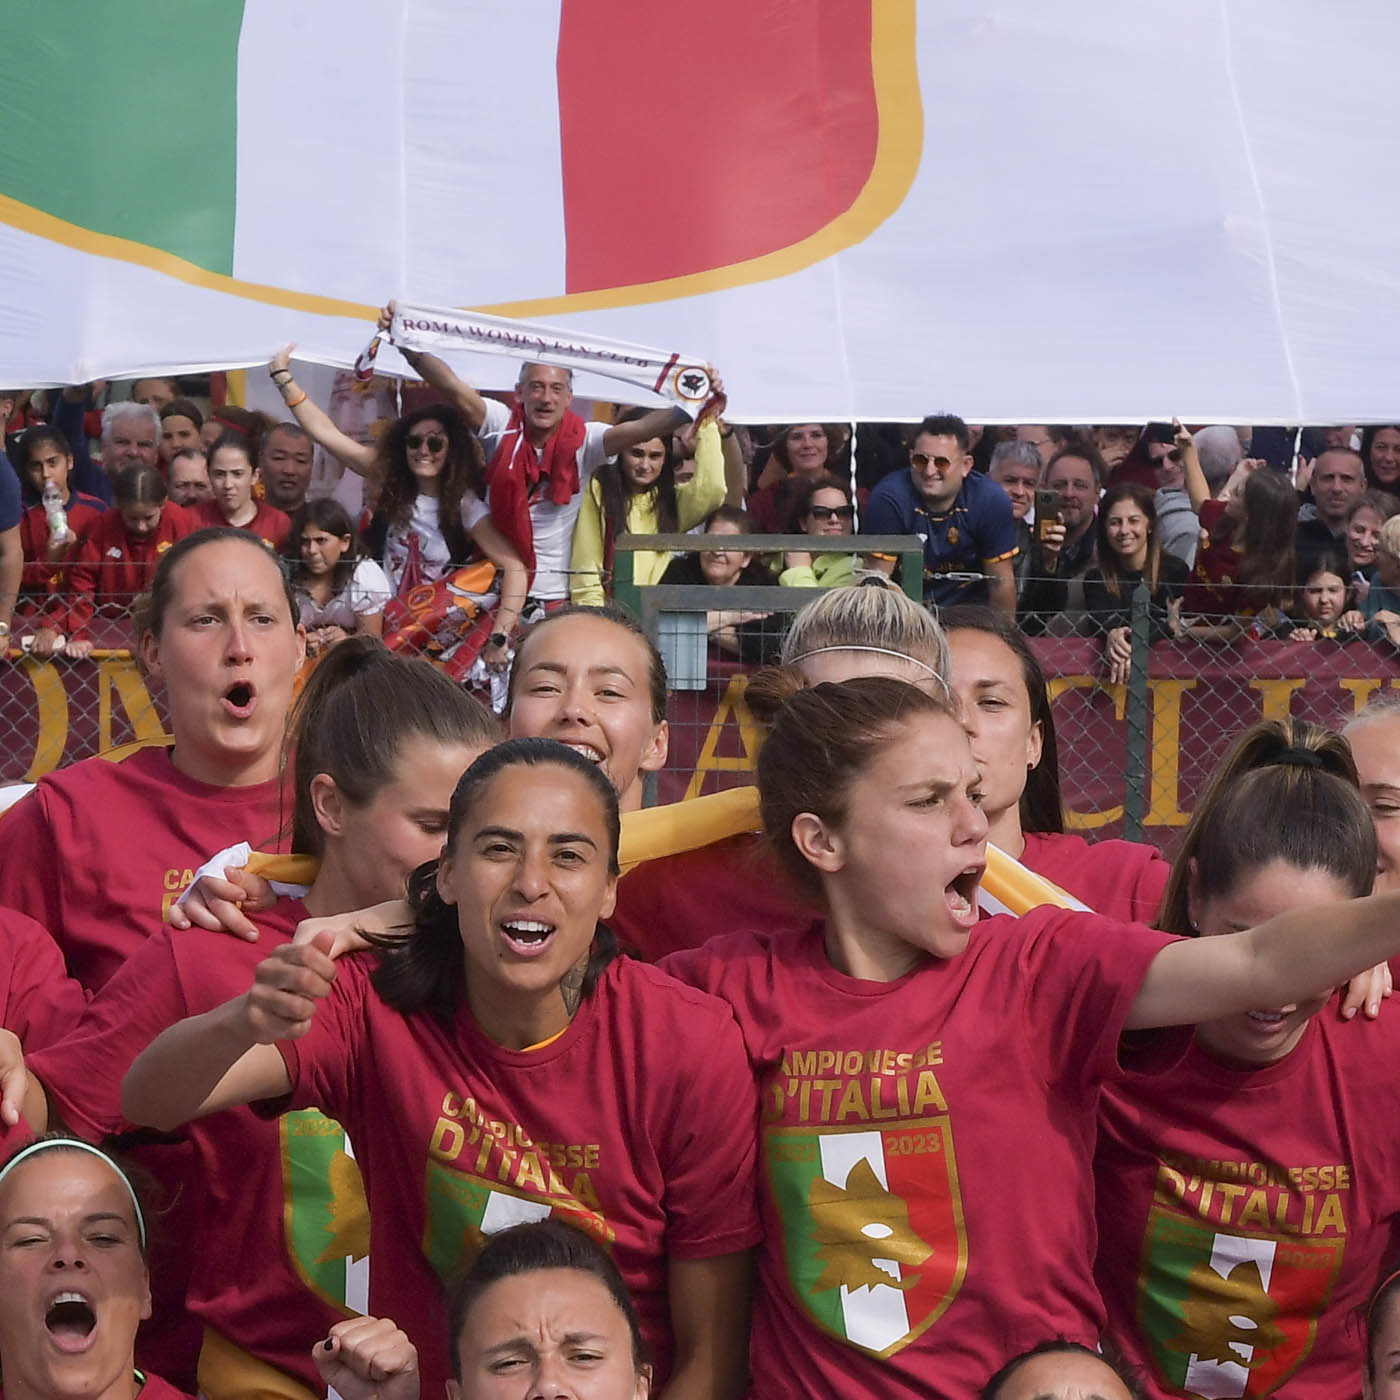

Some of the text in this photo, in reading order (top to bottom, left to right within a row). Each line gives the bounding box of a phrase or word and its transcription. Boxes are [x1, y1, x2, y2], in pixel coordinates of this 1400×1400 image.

[402, 317, 463, 335] ROMA
[469, 325, 548, 348] WOMEN
[292, 1117, 343, 1137] 2022
[887, 1132, 941, 1157] 2023
[1153, 1166, 1348, 1235] D'ITALIA
